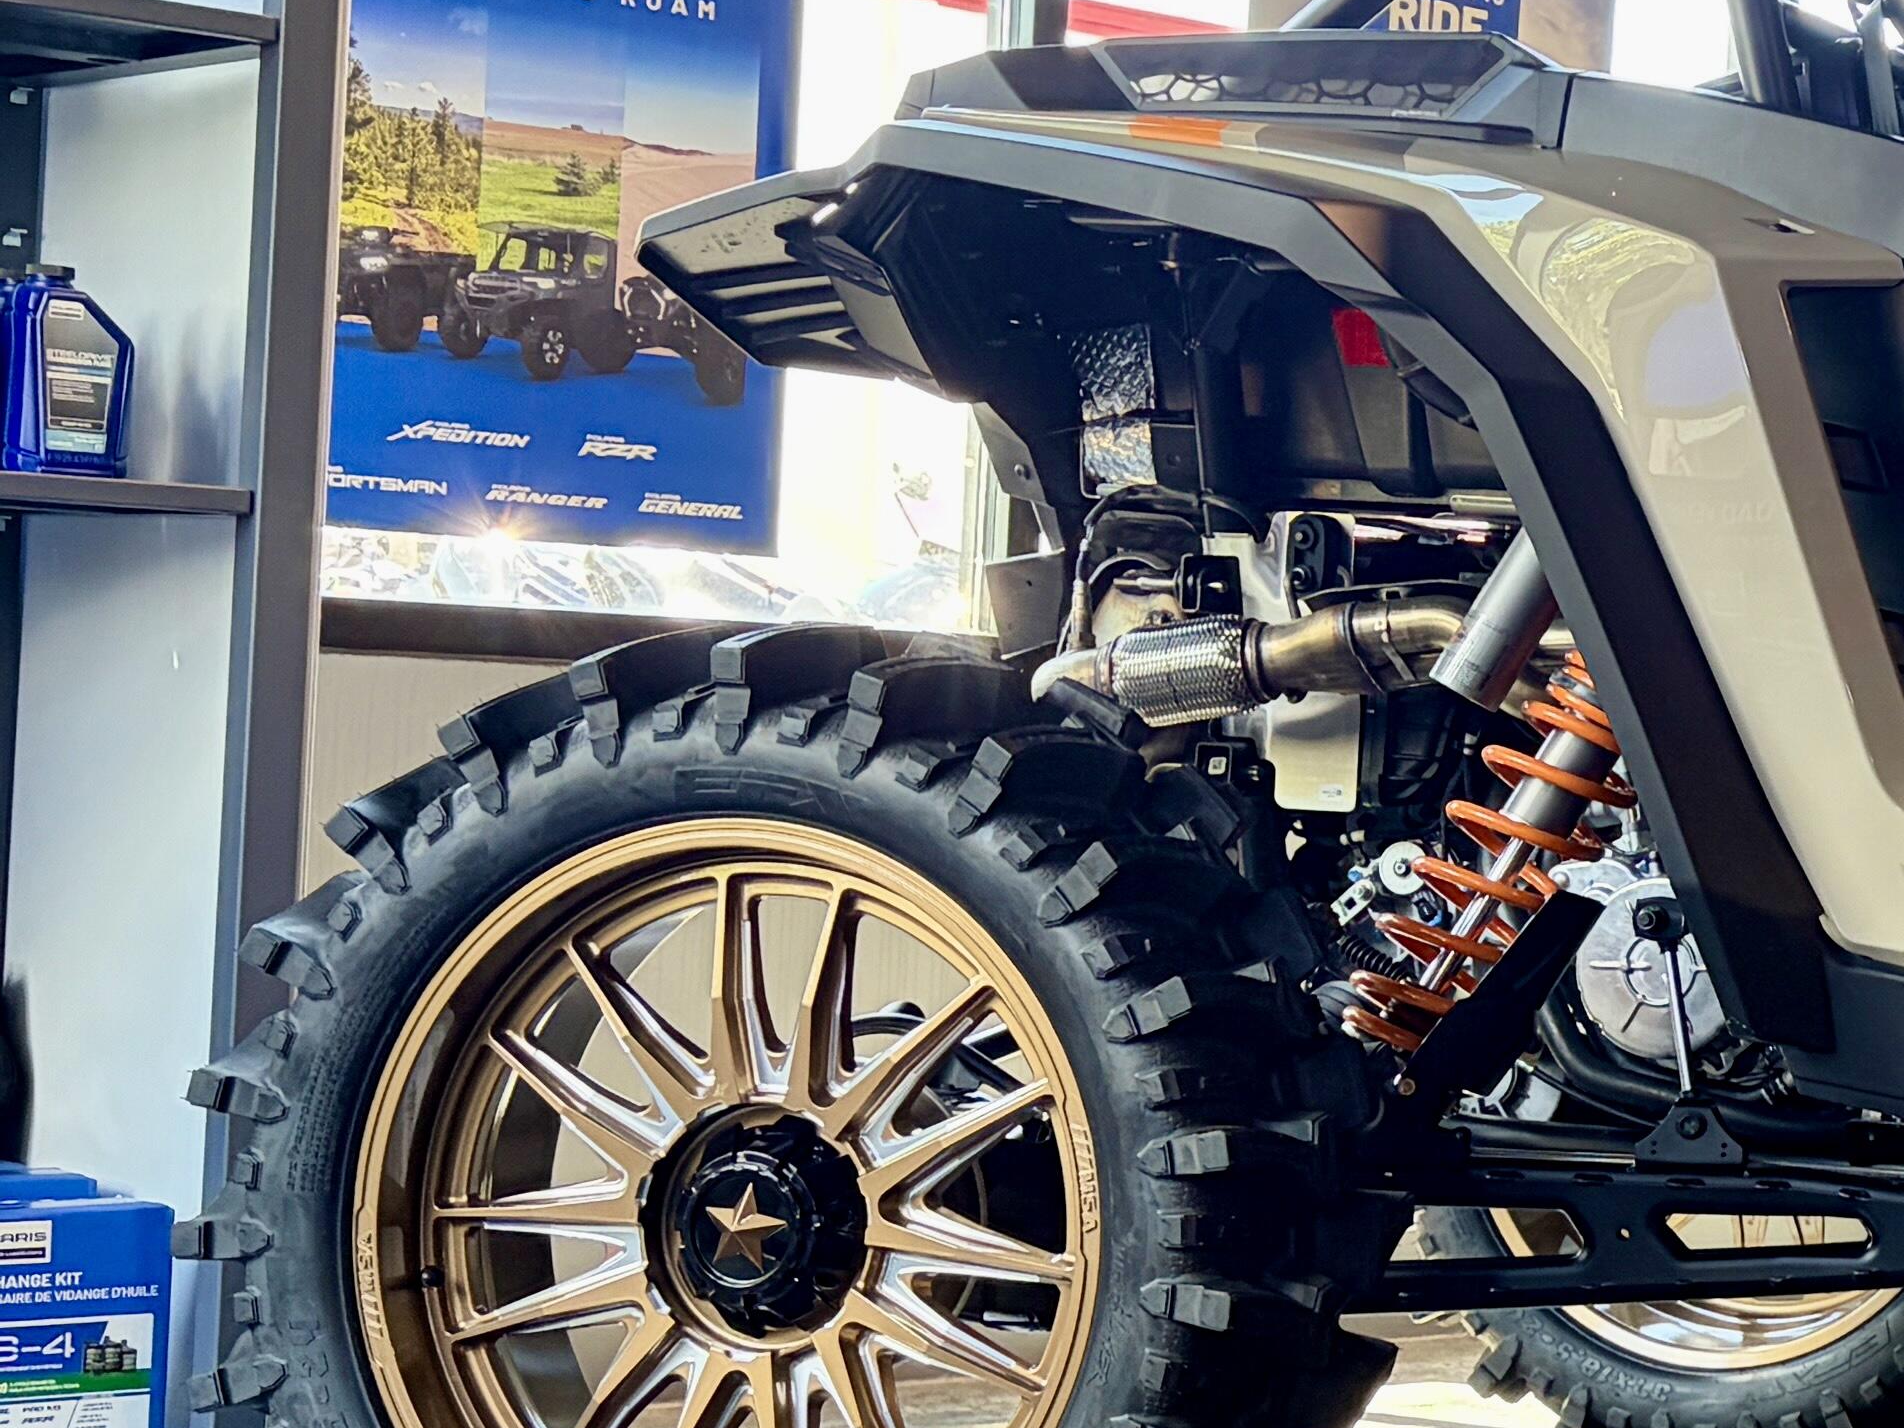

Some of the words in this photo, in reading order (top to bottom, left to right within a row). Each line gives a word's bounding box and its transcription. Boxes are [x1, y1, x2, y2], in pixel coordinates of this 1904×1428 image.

[385, 420, 530, 449] XPEDITION
[577, 441, 658, 461] RZR
[327, 472, 448, 496] ORTSMAN
[484, 488, 609, 510] RANGER
[637, 498, 744, 521] GENERAL
[0, 1231, 47, 1244] ARIS
[0, 1272, 52, 1290] HANGE
[55, 1271, 83, 1287] KIT
[35, 1291, 52, 1303] DE
[54, 1288, 110, 1302] VIDANGE
[0, 1331, 76, 1363] S-4
